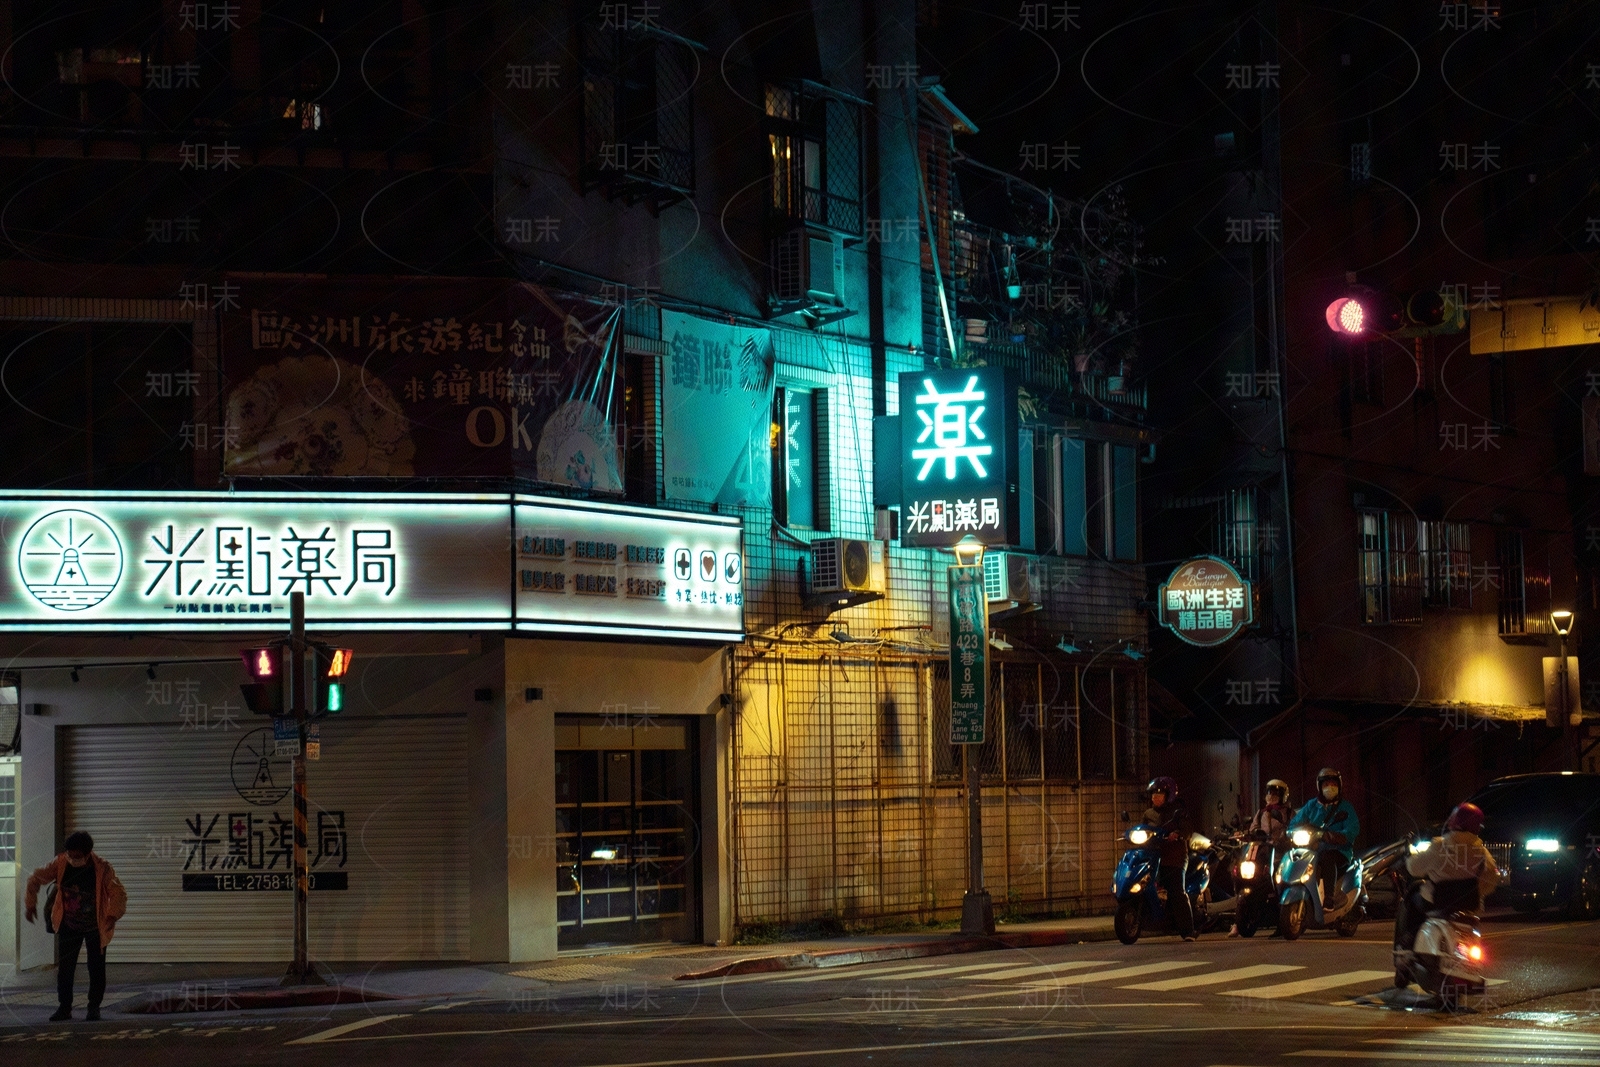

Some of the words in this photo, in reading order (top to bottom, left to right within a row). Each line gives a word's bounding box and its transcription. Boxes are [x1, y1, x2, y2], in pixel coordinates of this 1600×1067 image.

[250, 308, 552, 360] 歐洲旅遊紀念品
[1167, 588, 1244, 610] 歐洲生活
[1179, 610, 1233, 630] 精品館
[953, 702, 978, 710] Zhuang
[953, 710, 967, 718] Jing
[952, 733, 968, 741] Alley
